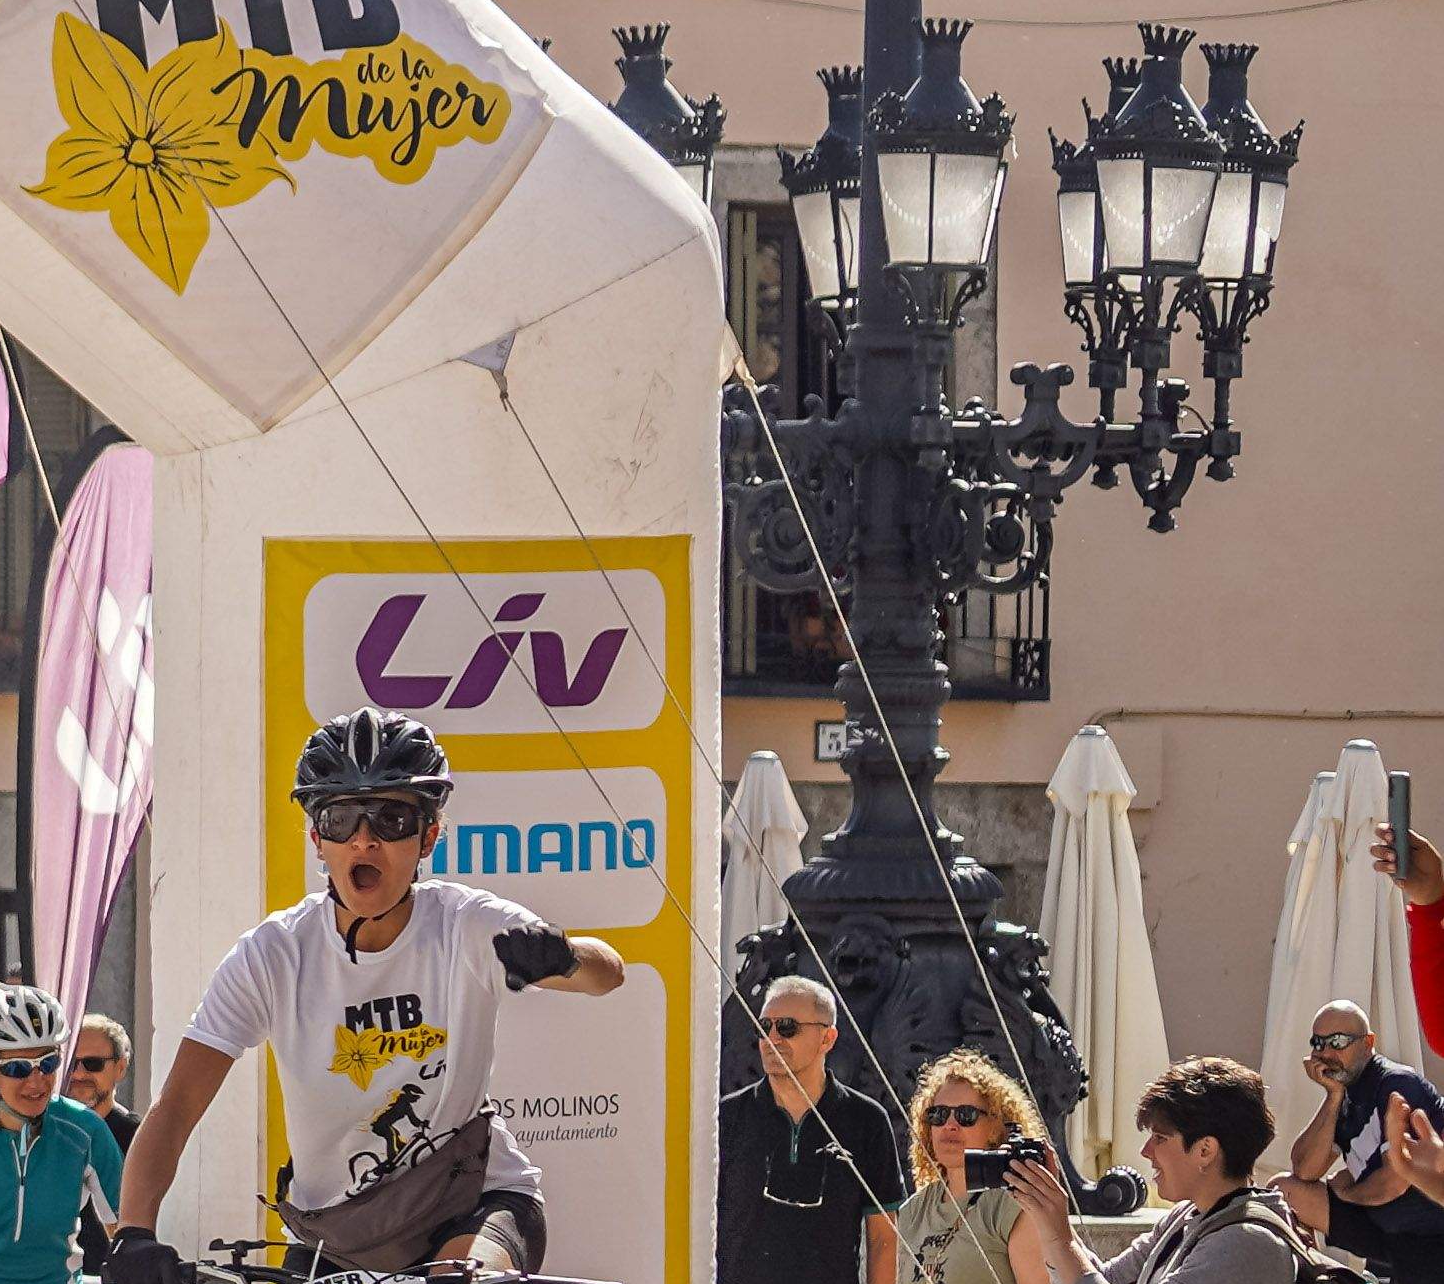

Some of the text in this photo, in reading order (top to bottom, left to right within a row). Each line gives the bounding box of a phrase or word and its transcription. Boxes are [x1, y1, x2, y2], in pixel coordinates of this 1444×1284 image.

[358, 47, 434, 82] de la
[211, 66, 499, 166] Mujer
[356, 593, 628, 709] Liv
[432, 818, 655, 874] IMANO
[345, 993, 423, 1034] MTB
[372, 1033, 446, 1058] Mujer
[522, 1093, 620, 1119] MOLINOS
[515, 1122, 619, 1148] ayuntamiento
